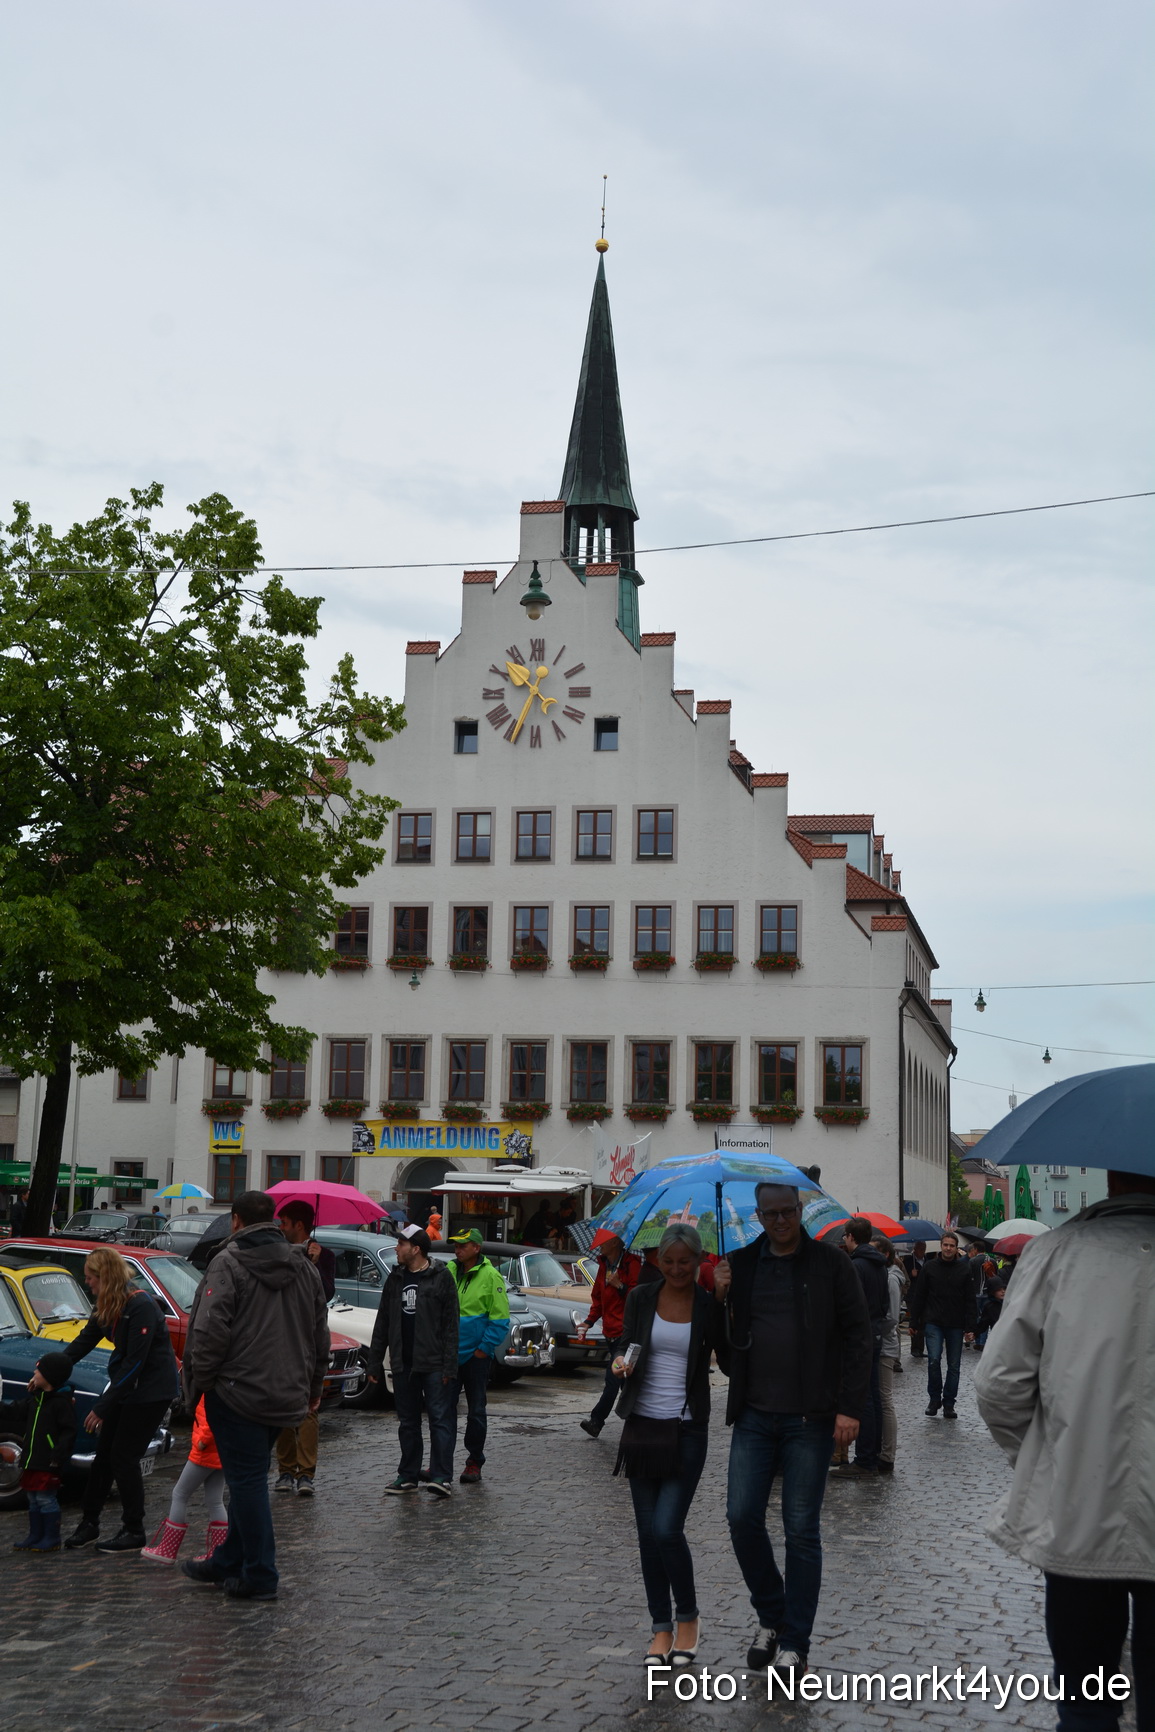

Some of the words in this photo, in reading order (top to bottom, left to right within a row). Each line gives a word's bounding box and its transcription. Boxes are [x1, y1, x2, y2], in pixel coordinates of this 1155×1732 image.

[529, 638, 545, 662] XII
[552, 644, 566, 666] I
[563, 662, 586, 679] II
[568, 686, 591, 698] III
[213, 1120, 242, 1141] WC
[379, 1126, 501, 1150] ANMELDUNG
[719, 1139, 770, 1149] Information
